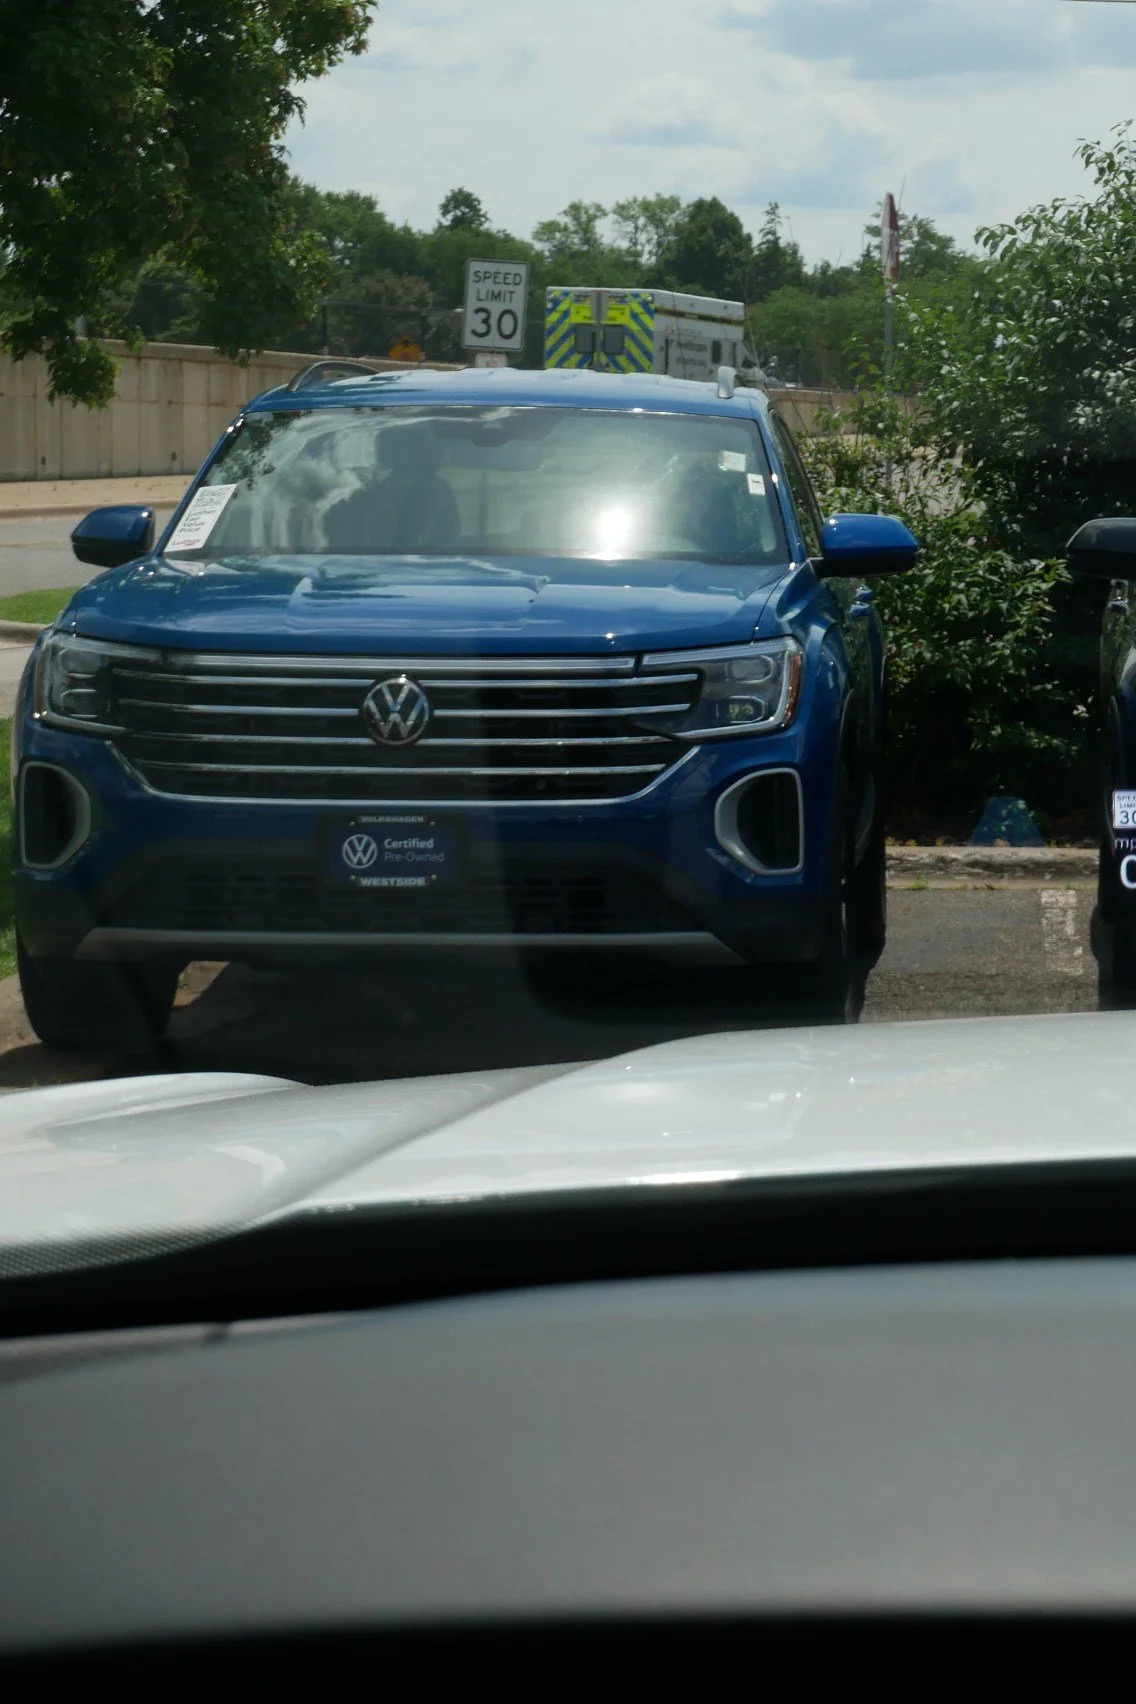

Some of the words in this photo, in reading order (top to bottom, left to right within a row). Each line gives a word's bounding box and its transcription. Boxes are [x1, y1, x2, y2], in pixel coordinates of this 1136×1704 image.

[473, 270, 522, 286] SPEED
[476, 288, 516, 304] LIMIT
[470, 307, 519, 340] 30
[359, 815, 425, 823] VOLKSWAGEN
[384, 838, 434, 849] Certified
[384, 850, 445, 862] Pre-Owned
[359, 877, 427, 887] WESTSIDE
